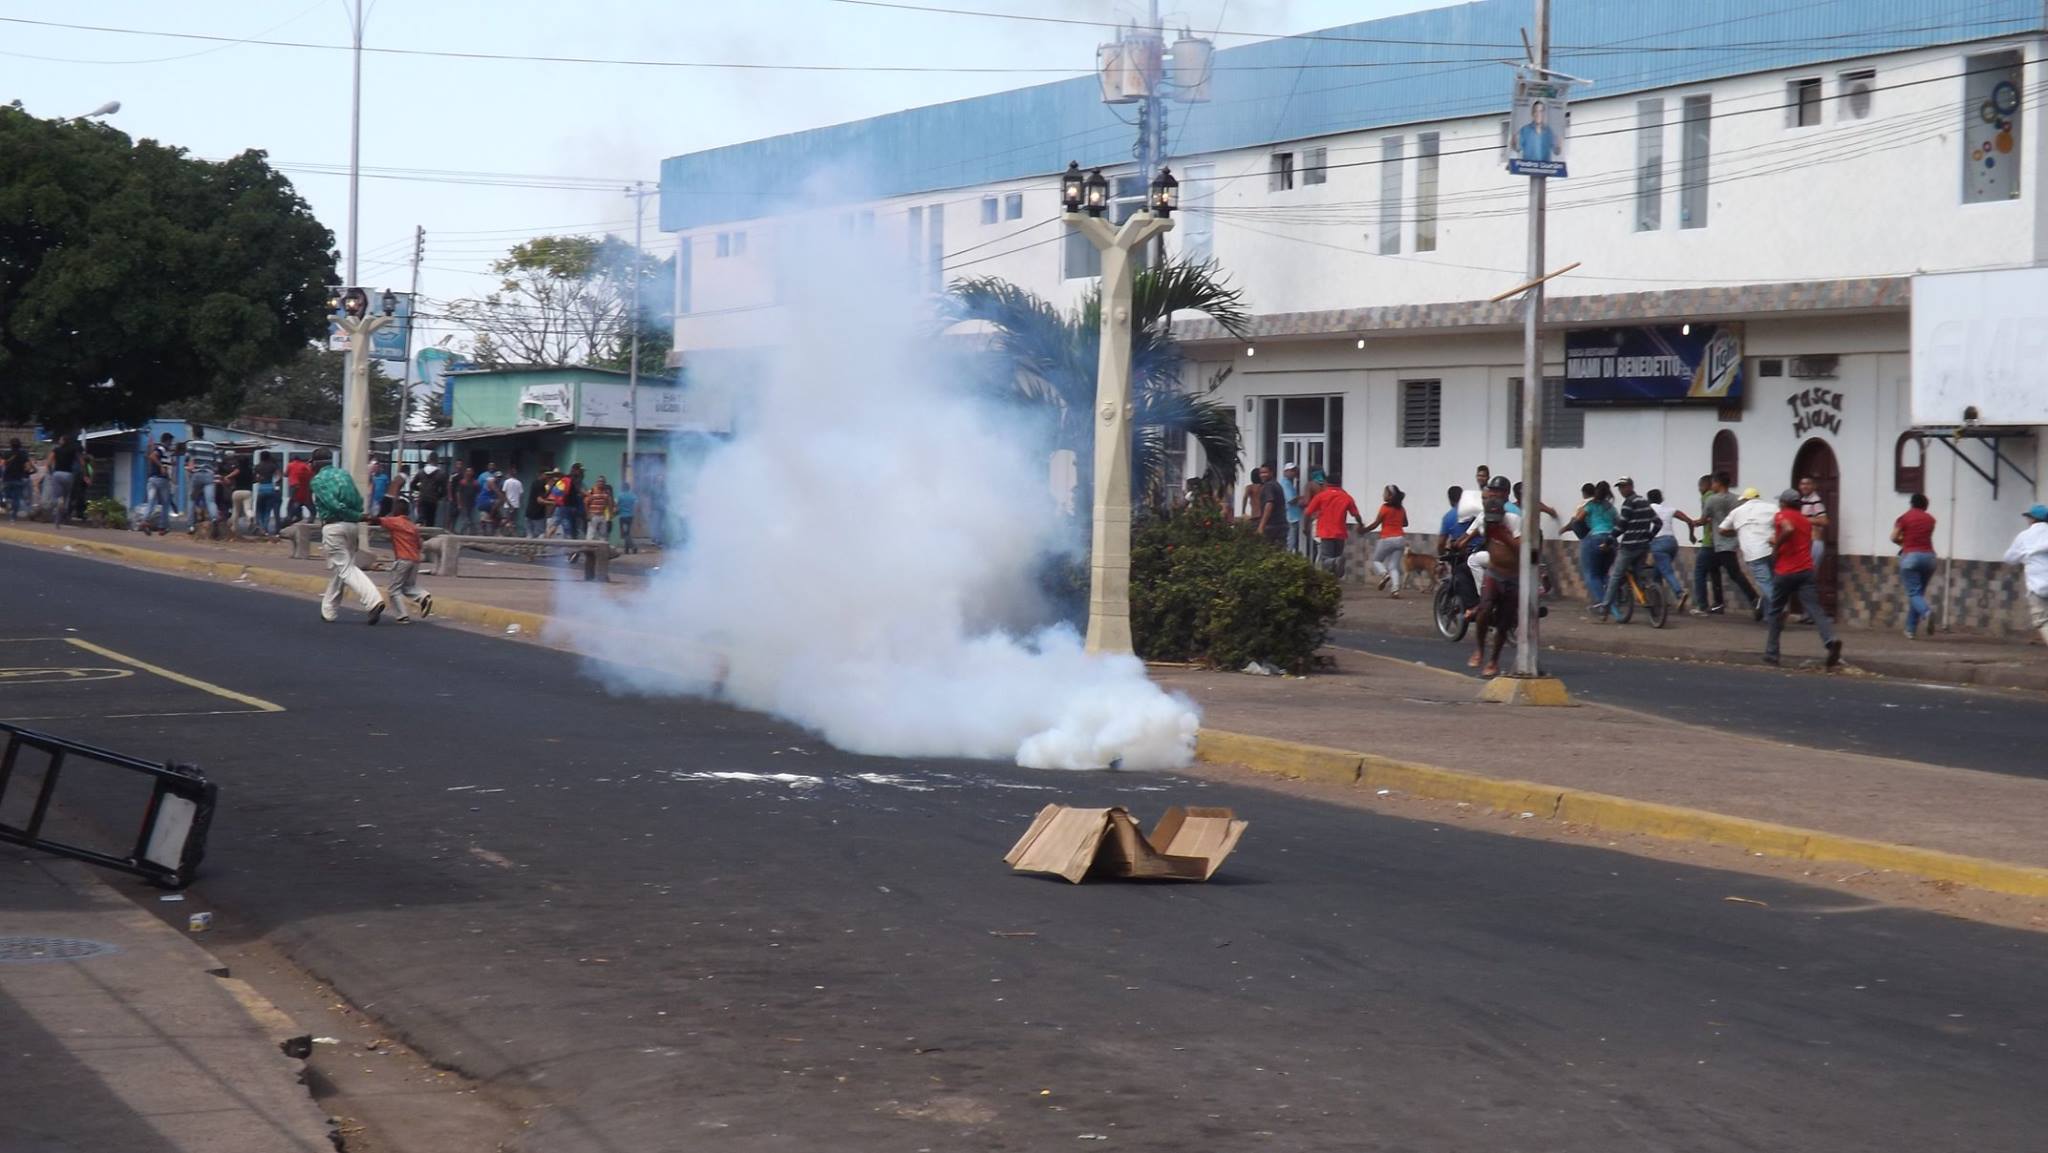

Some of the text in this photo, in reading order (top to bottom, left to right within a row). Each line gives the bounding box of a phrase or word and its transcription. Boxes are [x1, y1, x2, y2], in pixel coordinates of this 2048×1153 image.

[1567, 358, 1600, 379] MIAMI
[1603, 357, 1615, 378] DI
[1617, 355, 1680, 378] BENEDETTO
